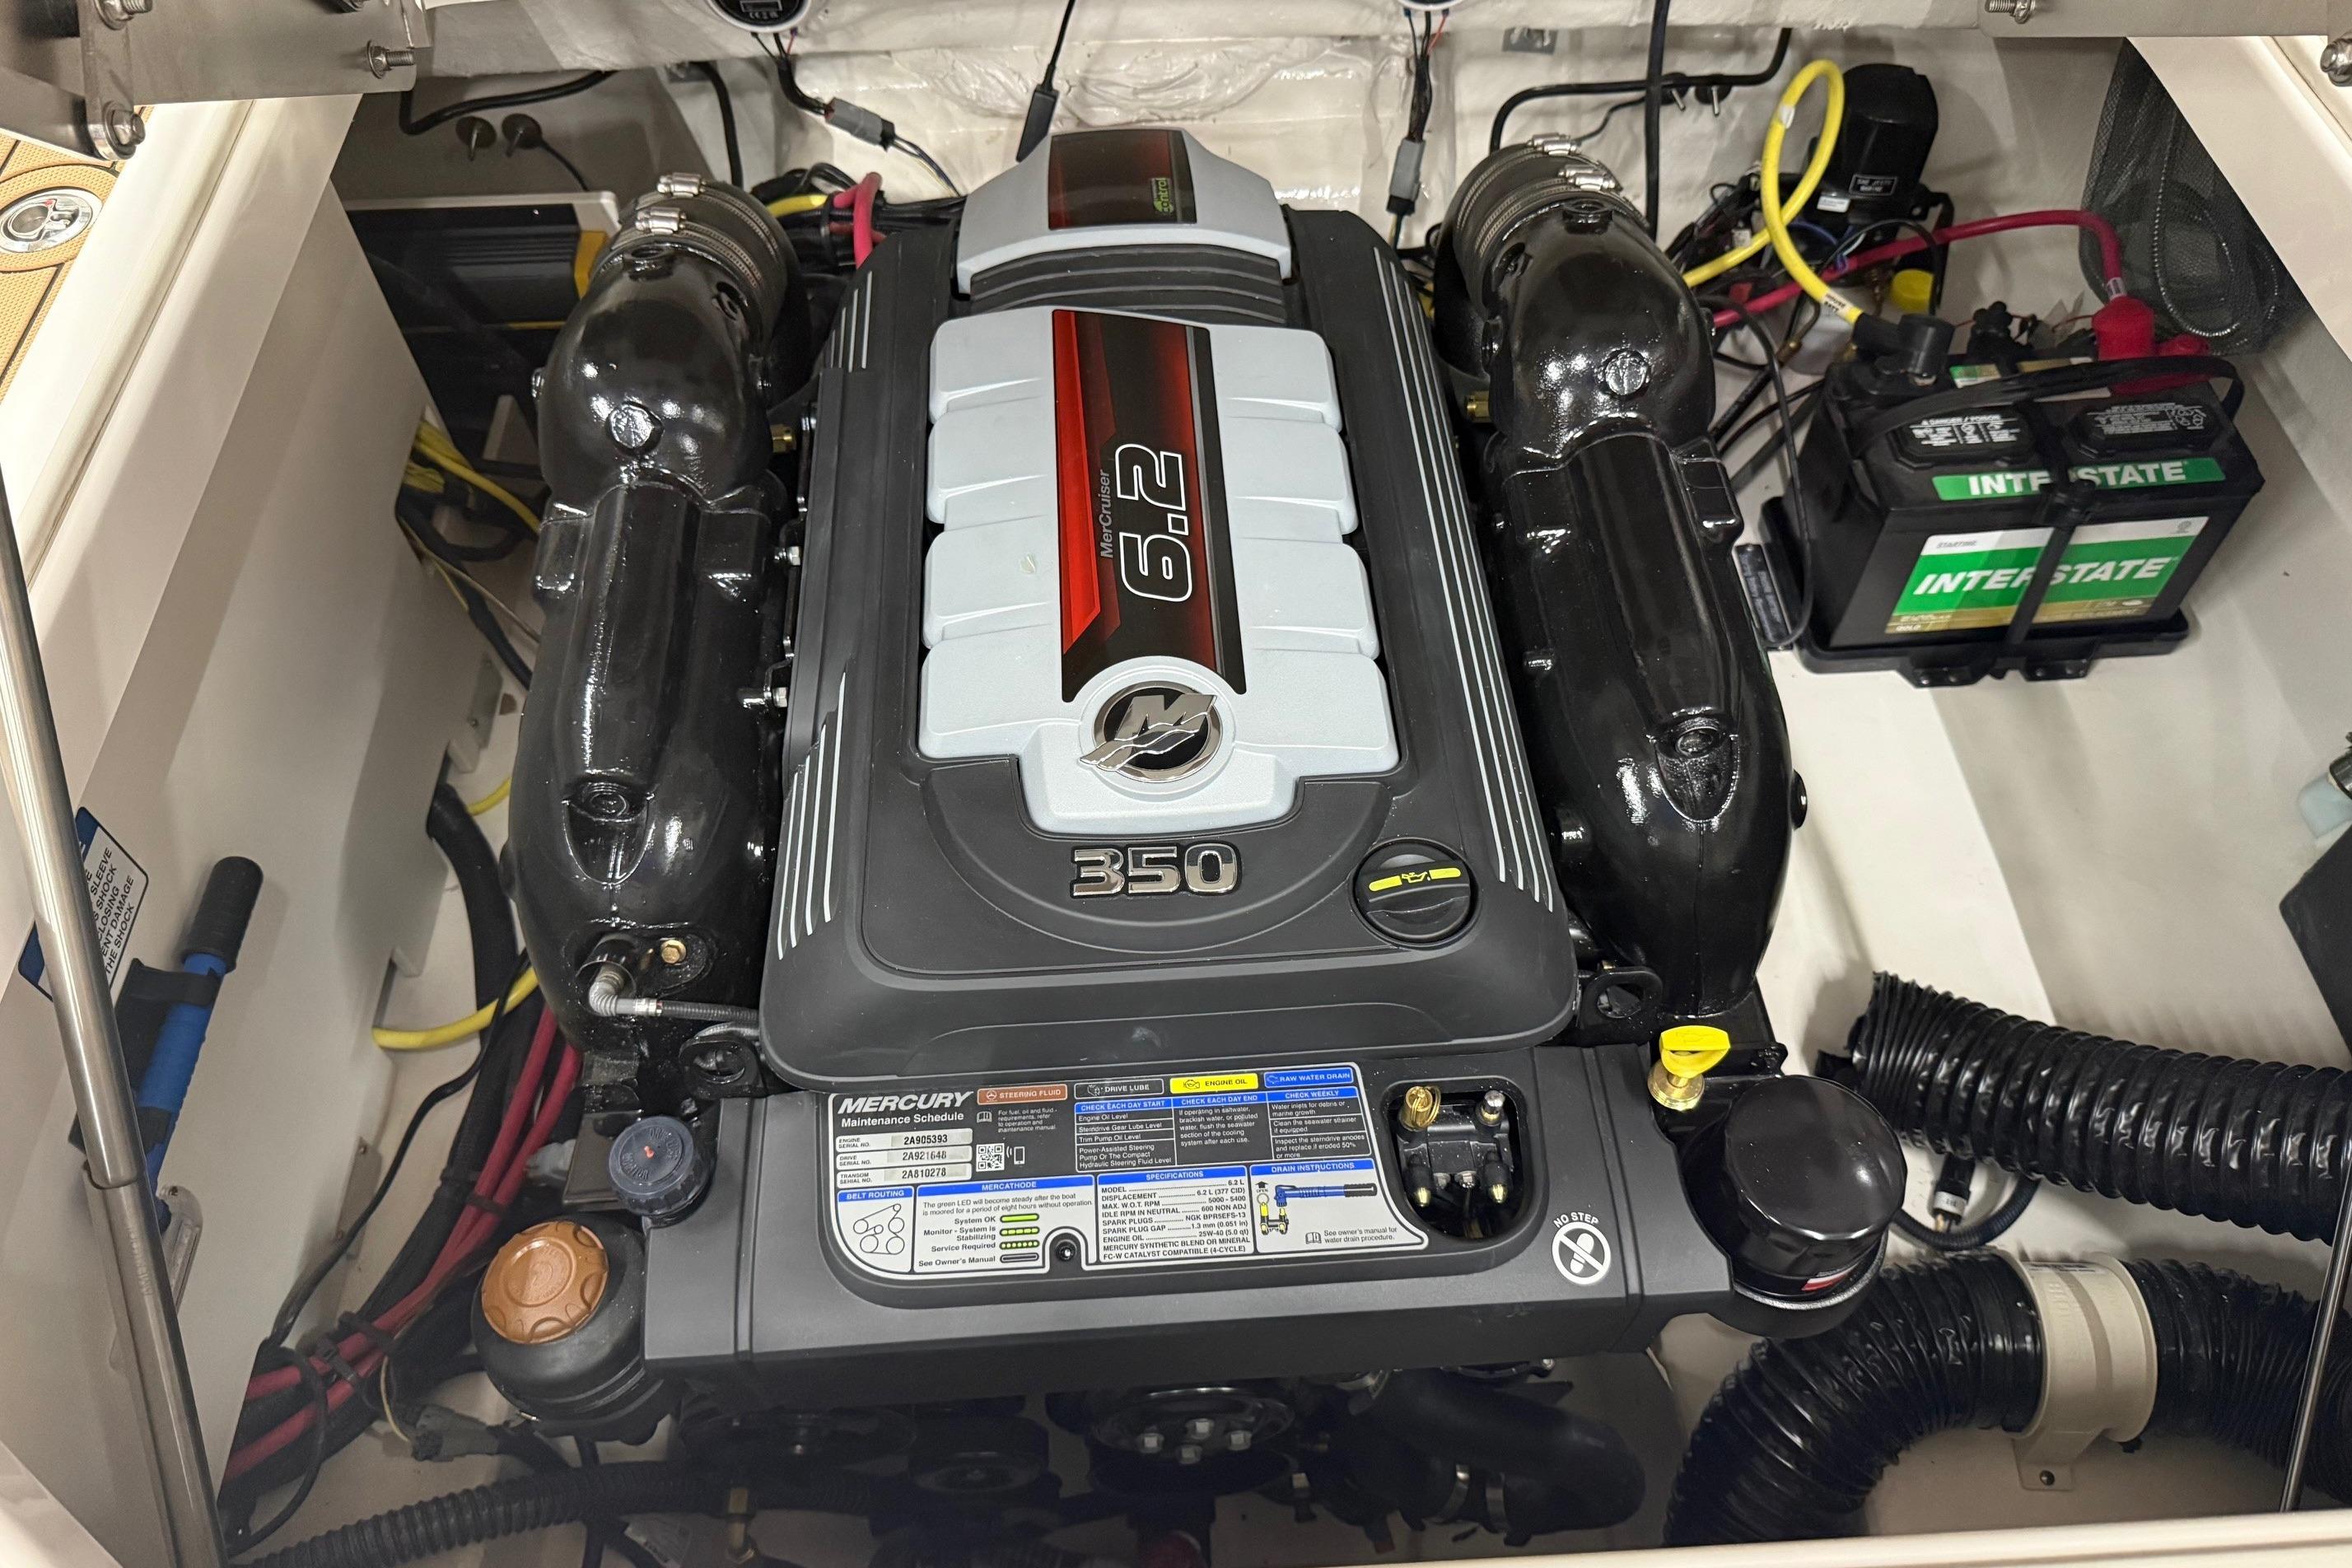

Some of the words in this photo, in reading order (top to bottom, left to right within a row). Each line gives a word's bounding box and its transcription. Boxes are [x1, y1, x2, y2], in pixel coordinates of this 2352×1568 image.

[1967, 459, 2186, 496] INTESTATE
[1098, 469, 1113, 558] MerCruiser
[1115, 444, 1192, 602] 6.2
[91, 847, 112, 895] SLEEVE
[1072, 842, 1239, 897] 350
[96, 865, 117, 910] SHOCK
[111, 875, 134, 930] DAMAGE
[114, 904, 134, 948] SHOCK
[838, 1091, 973, 1113] MERCURY
[842, 1114, 910, 1127] Maintenance
[913, 1112, 964, 1122] Schedule
[903, 1135, 948, 1146] 2A905393
[1080, 1145, 1127, 1154] Power-Assisted
[903, 1151, 947, 1161] 2A921648
[1297, 1163, 1355, 1171] INSTRUCTIONS
[902, 1168, 946, 1179] 2A810278
[1146, 1171, 1204, 1180] SPECIFICATIONS
[982, 1182, 1037, 1191] MERCATHODE
[1101, 1192, 1157, 1202] DISPLACEMENT
[1001, 1204, 1017, 1212] eight
[1147, 1207, 1180, 1216] NEUTRAL
[1553, 1215, 1569, 1228] NO
[1570, 1212, 1599, 1225] STEP
[1239, 1228, 1248, 1236] qt)
[1104, 1244, 1138, 1252] MERCURY
[1140, 1241, 1179, 1249] SYNTHETIC
[1124, 1250, 1160, 1258] CATALYST
[1162, 1247, 1209, 1257] COMPATIBLE
[1210, 1245, 1245, 1254] (4-CYCLE)
